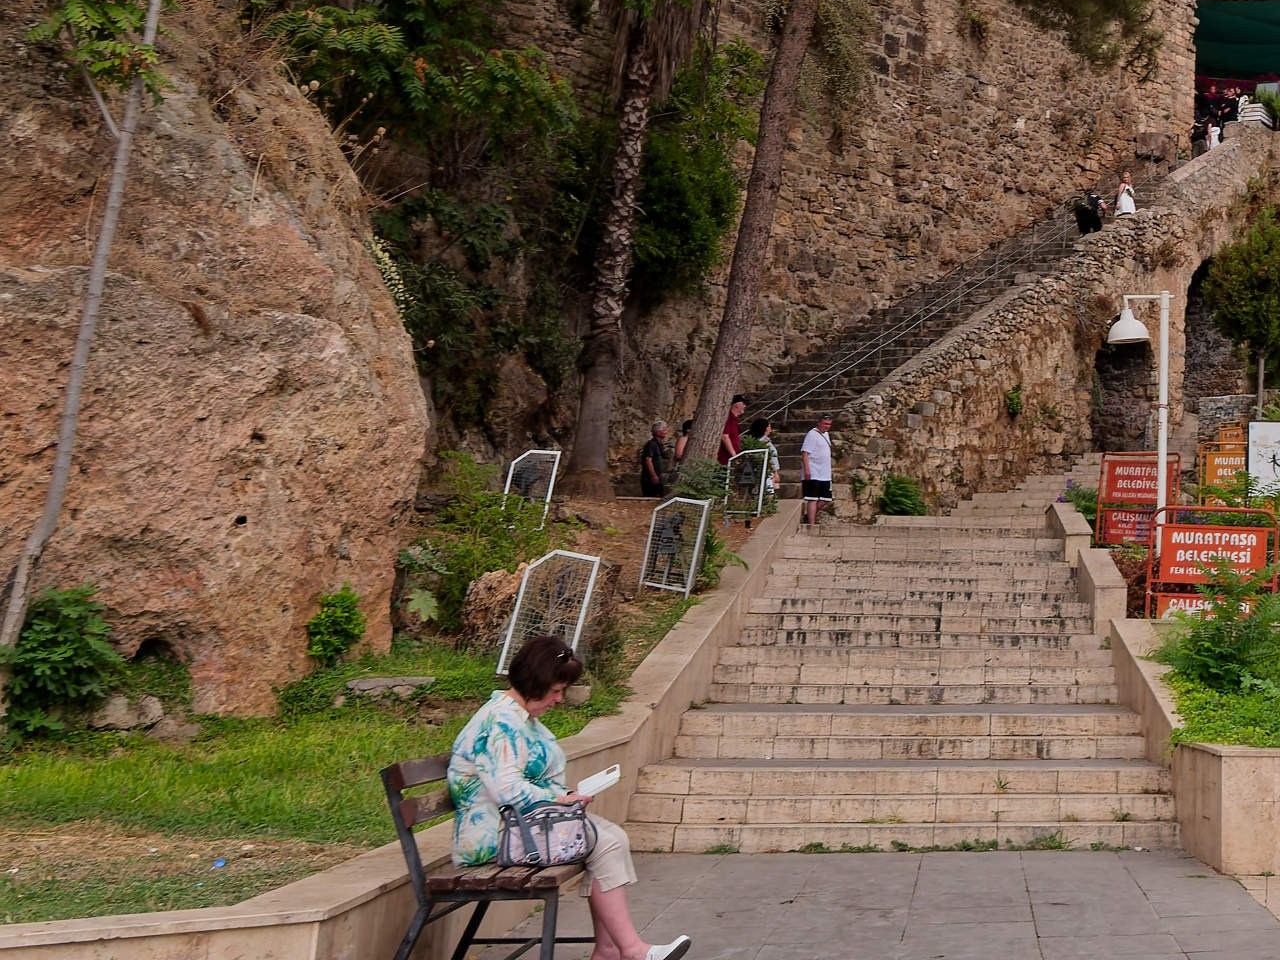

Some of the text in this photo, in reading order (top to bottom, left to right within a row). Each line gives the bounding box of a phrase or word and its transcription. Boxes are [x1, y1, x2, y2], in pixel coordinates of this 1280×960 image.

[1214, 457, 1246, 465] MURAT
[1115, 466, 1158, 476] MURATPA
[1171, 531, 1257, 548] MURATPAŞA
[1169, 566, 1184, 574] FEN
